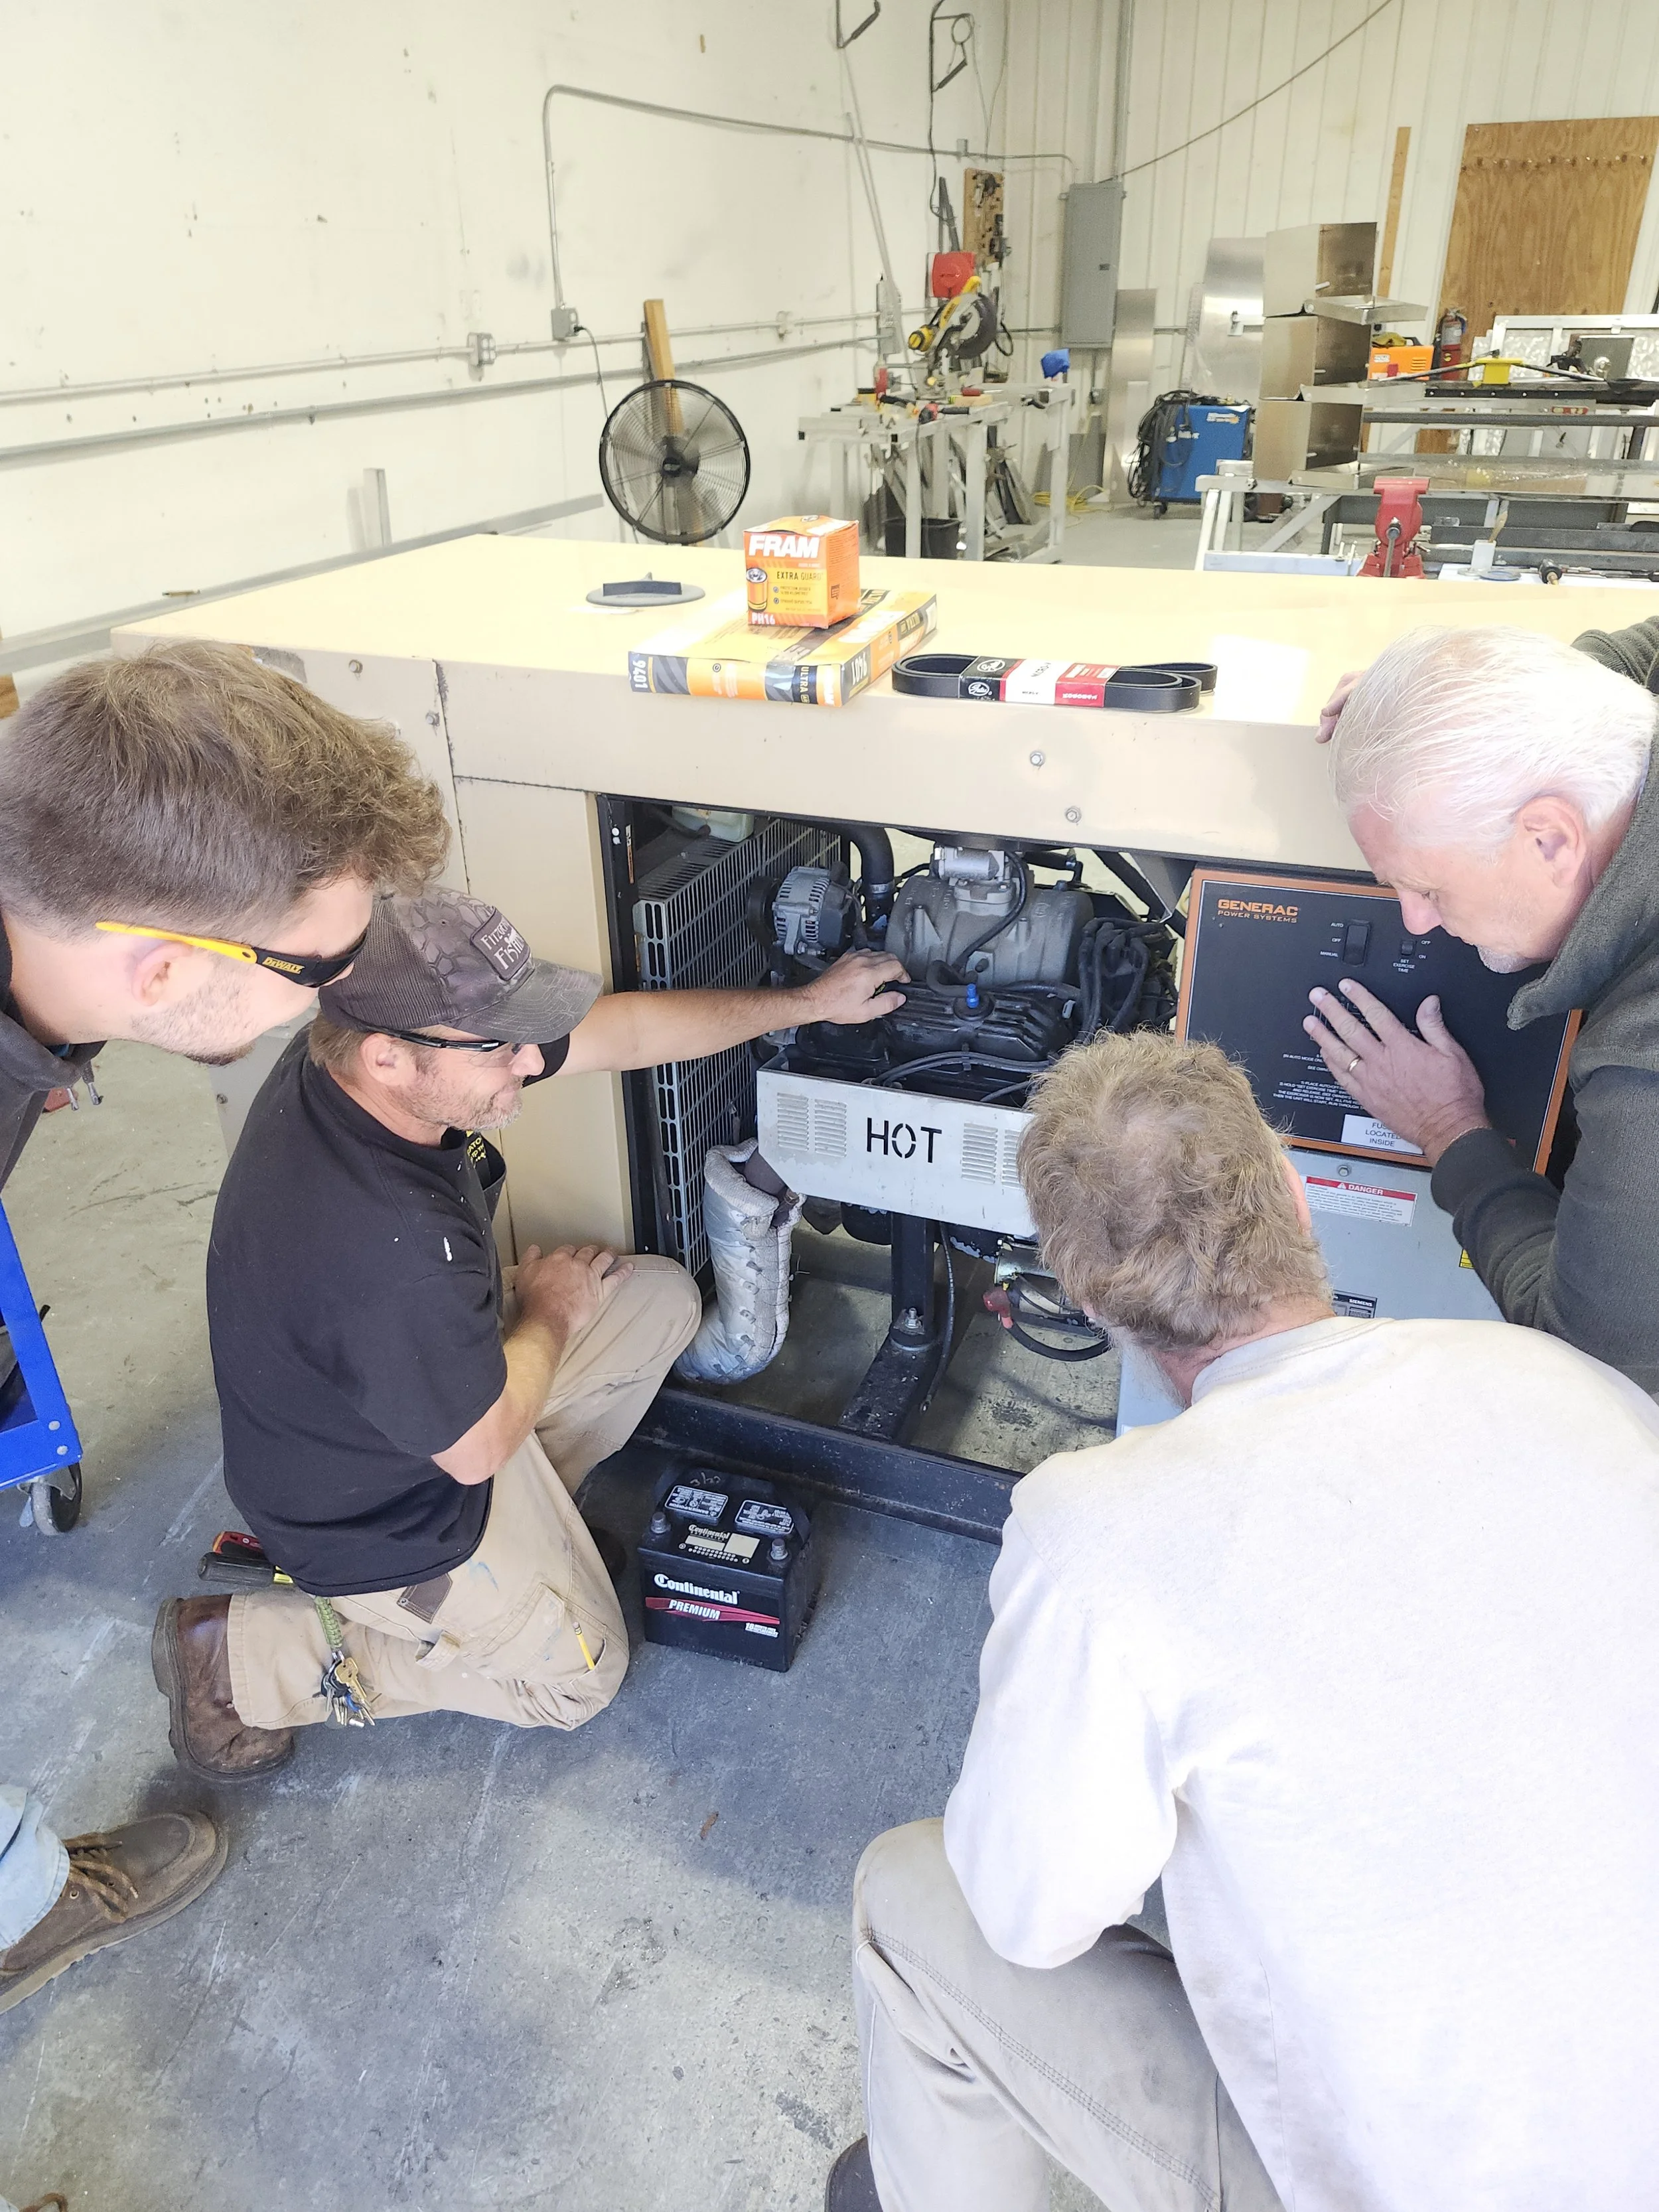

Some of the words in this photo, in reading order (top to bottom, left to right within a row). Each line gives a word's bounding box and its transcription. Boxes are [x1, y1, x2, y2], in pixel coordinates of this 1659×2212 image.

[749, 535, 820, 558] FRAM
[776, 571, 798, 580] EXTRA
[752, 613, 776, 625] PH16
[632, 660, 648, 689] 9401
[800, 666, 809, 693] ULTRA
[1217, 899, 1299, 916] GENERAC
[1218, 910, 1250, 919] POWER
[1253, 914, 1297, 923] SYSTEMS
[866, 1117, 942, 1163] HOT
[1369, 1138, 1396, 1147] INSIDE
[1348, 1184, 1384, 1195] DANGER
[1349, 1298, 1373, 1307] SIEMENS
[688, 1524, 731, 1539] Continental
[654, 1574, 739, 1605] Continental
[668, 1599, 721, 1620] PREMIUM
